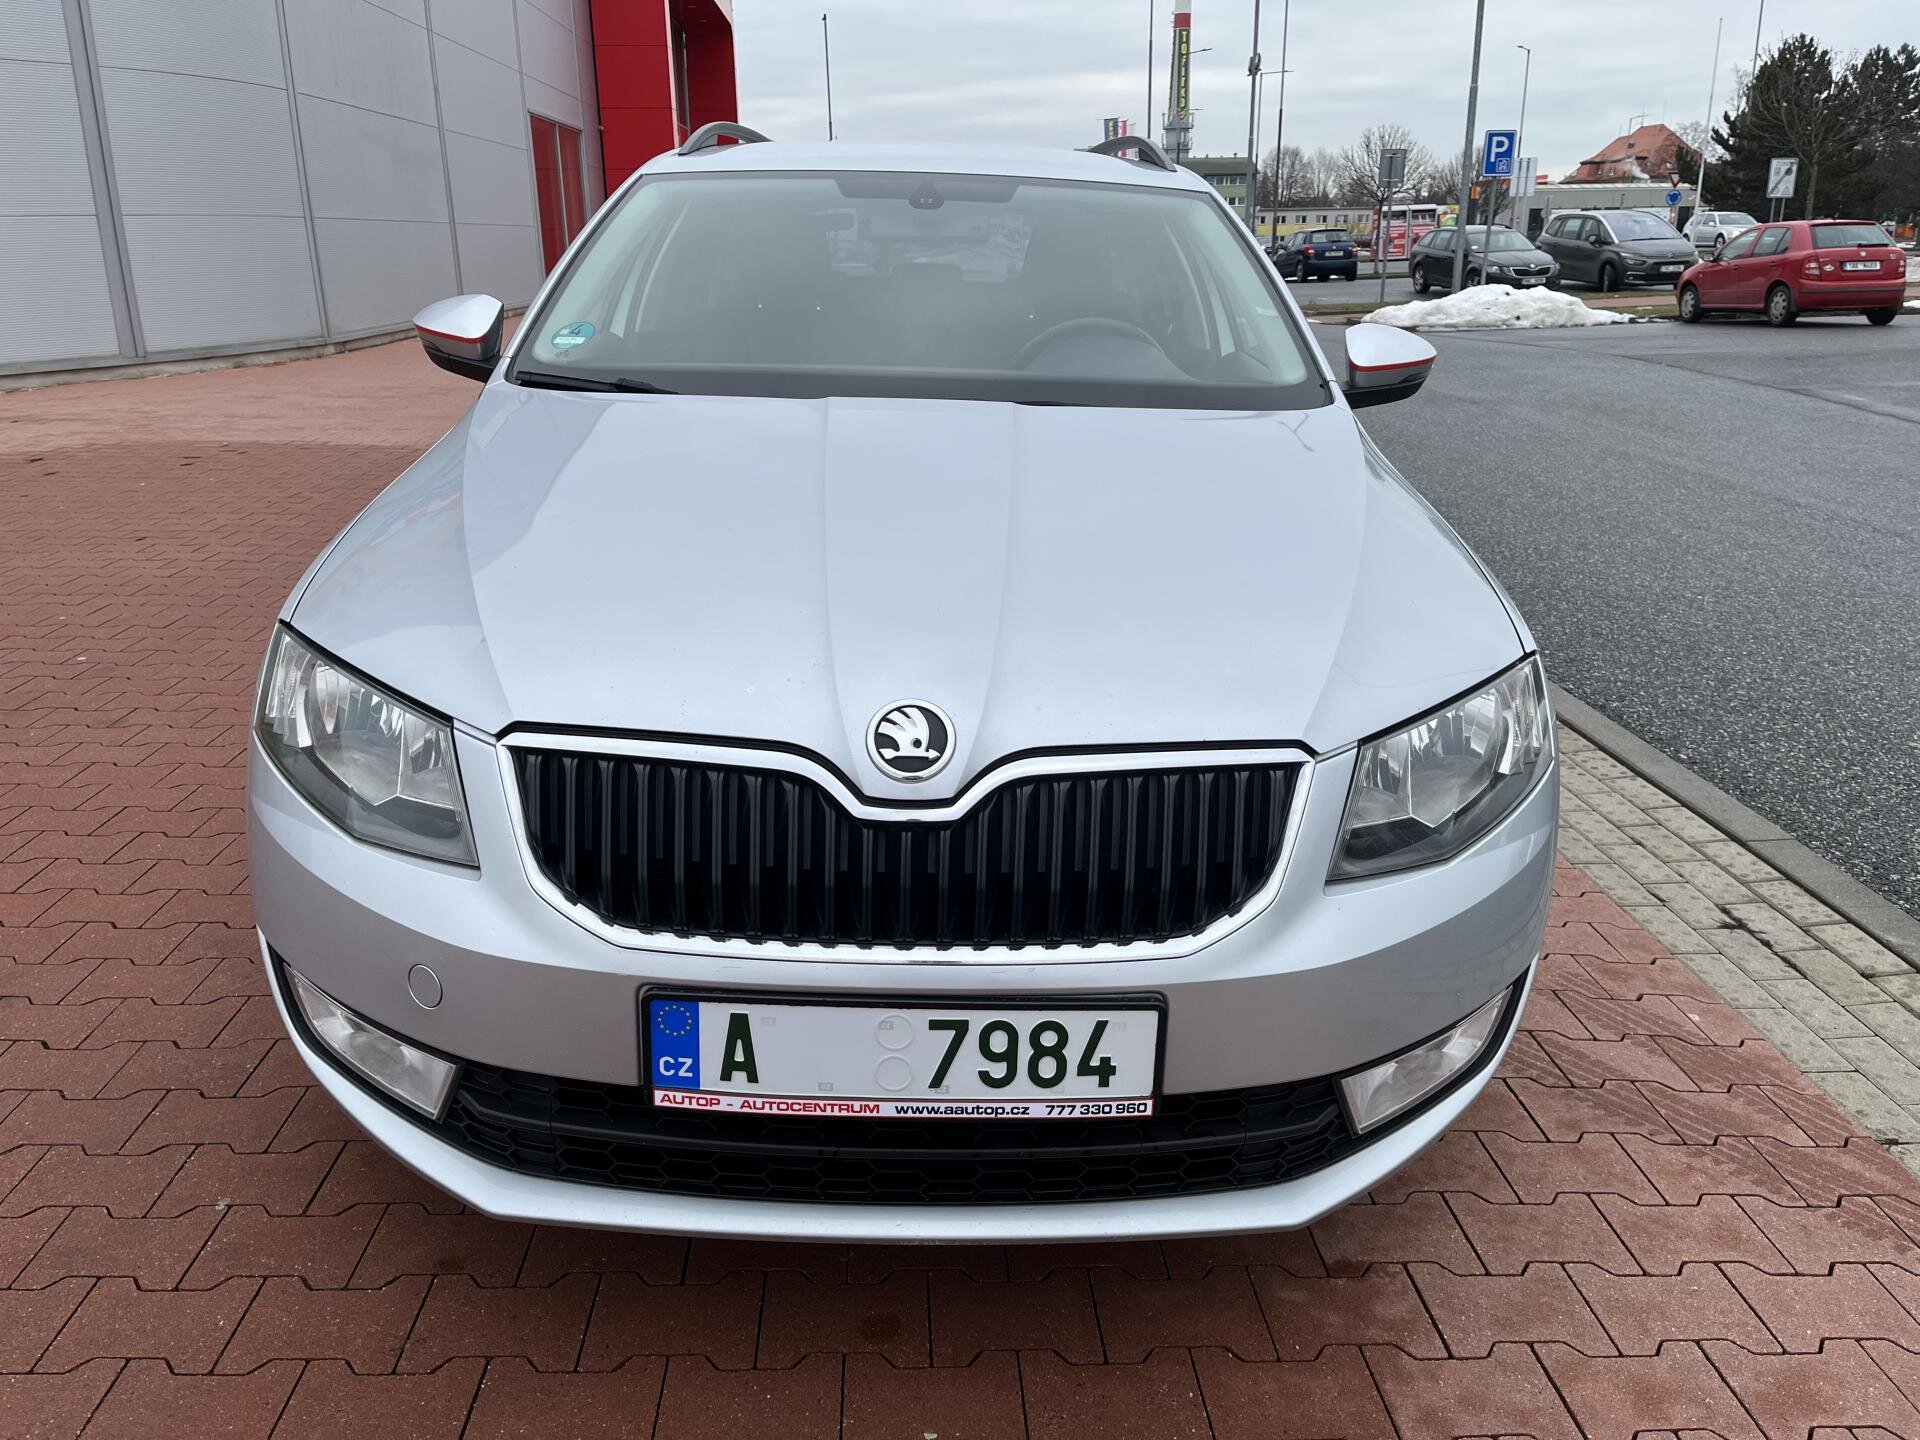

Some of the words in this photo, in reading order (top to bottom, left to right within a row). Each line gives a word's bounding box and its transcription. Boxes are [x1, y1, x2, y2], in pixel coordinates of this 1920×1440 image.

[1490, 136, 1509, 162] P
[719, 1012, 759, 1083] A
[928, 1018, 1117, 1089] 7984
[659, 1056, 693, 1078] CZ
[660, 1093, 721, 1108] AUTOP
[739, 1099, 880, 1115] AUTOCENTRUM
[894, 1104, 1030, 1118] www.aautop.cz
[1045, 1104, 1076, 1116] 777
[1079, 1104, 1112, 1116] 330
[1115, 1102, 1148, 1114] 960
